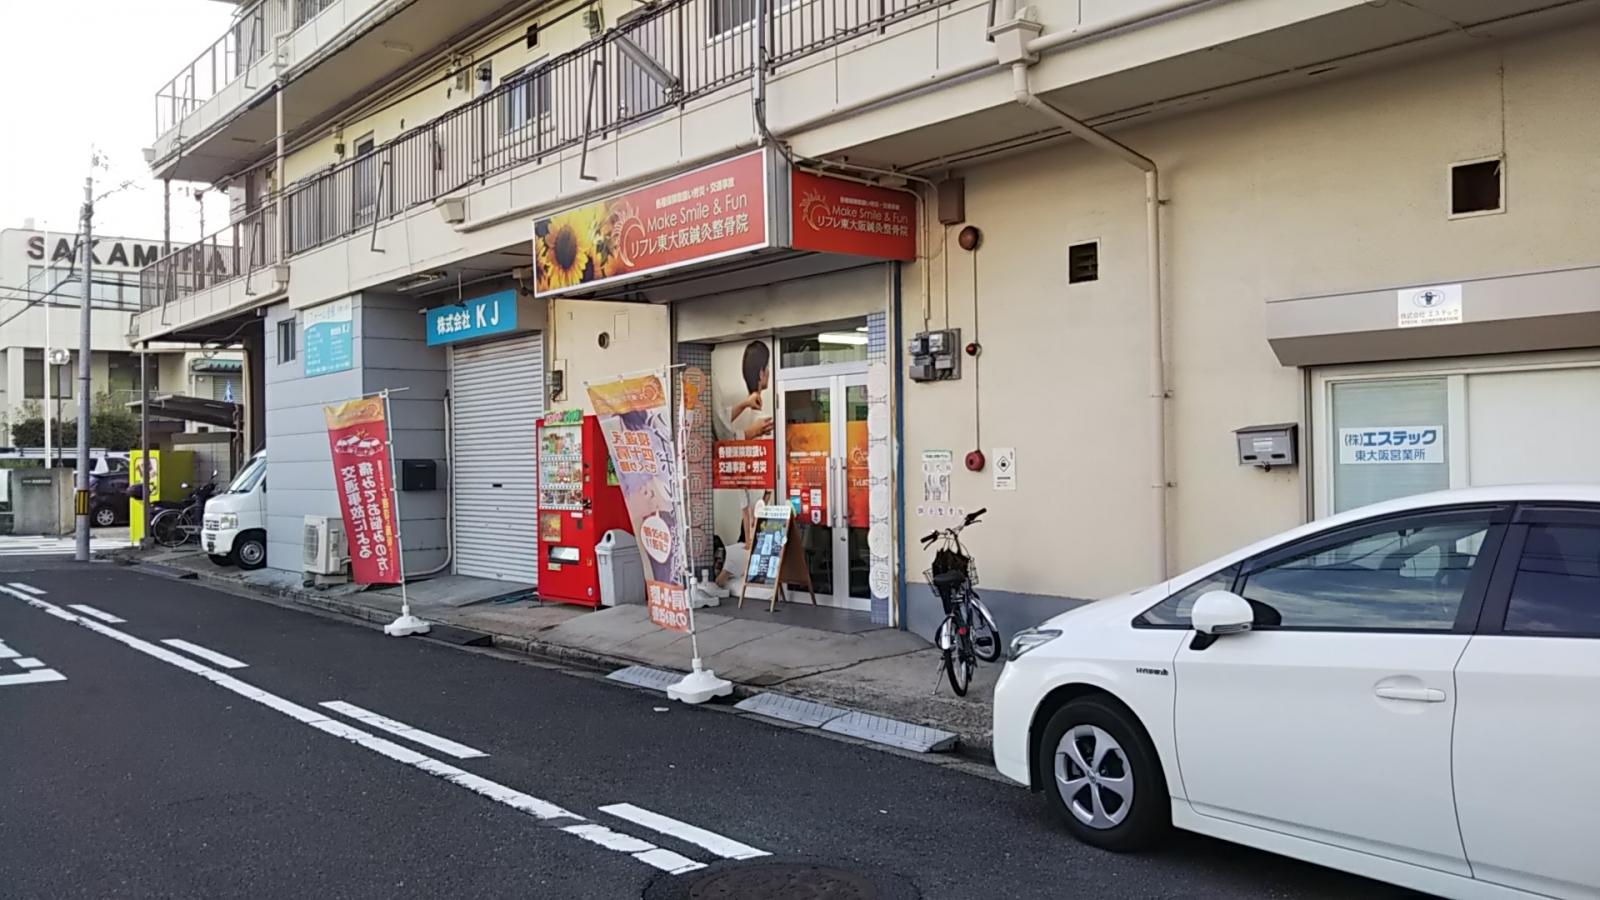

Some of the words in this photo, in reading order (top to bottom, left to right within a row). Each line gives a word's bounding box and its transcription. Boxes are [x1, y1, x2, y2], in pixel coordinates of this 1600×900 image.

[647, 211, 677, 232] Make
[680, 203, 710, 223] Smile
[713, 198, 721, 215] &
[725, 193, 747, 212] Fun
[832, 206, 857, 217] Make
[860, 208, 881, 220] Smile
[884, 212, 890, 222] &
[893, 213, 908, 223] Fun
[631, 213, 749, 259] リフレ東大阪鍼灸整骨院
[437, 309, 471, 335] 株式会社
[476, 301, 499, 328] KJ
[1345, 429, 1437, 447] (株)エステック
[1355, 448, 1426, 461] 東大阪営業所
